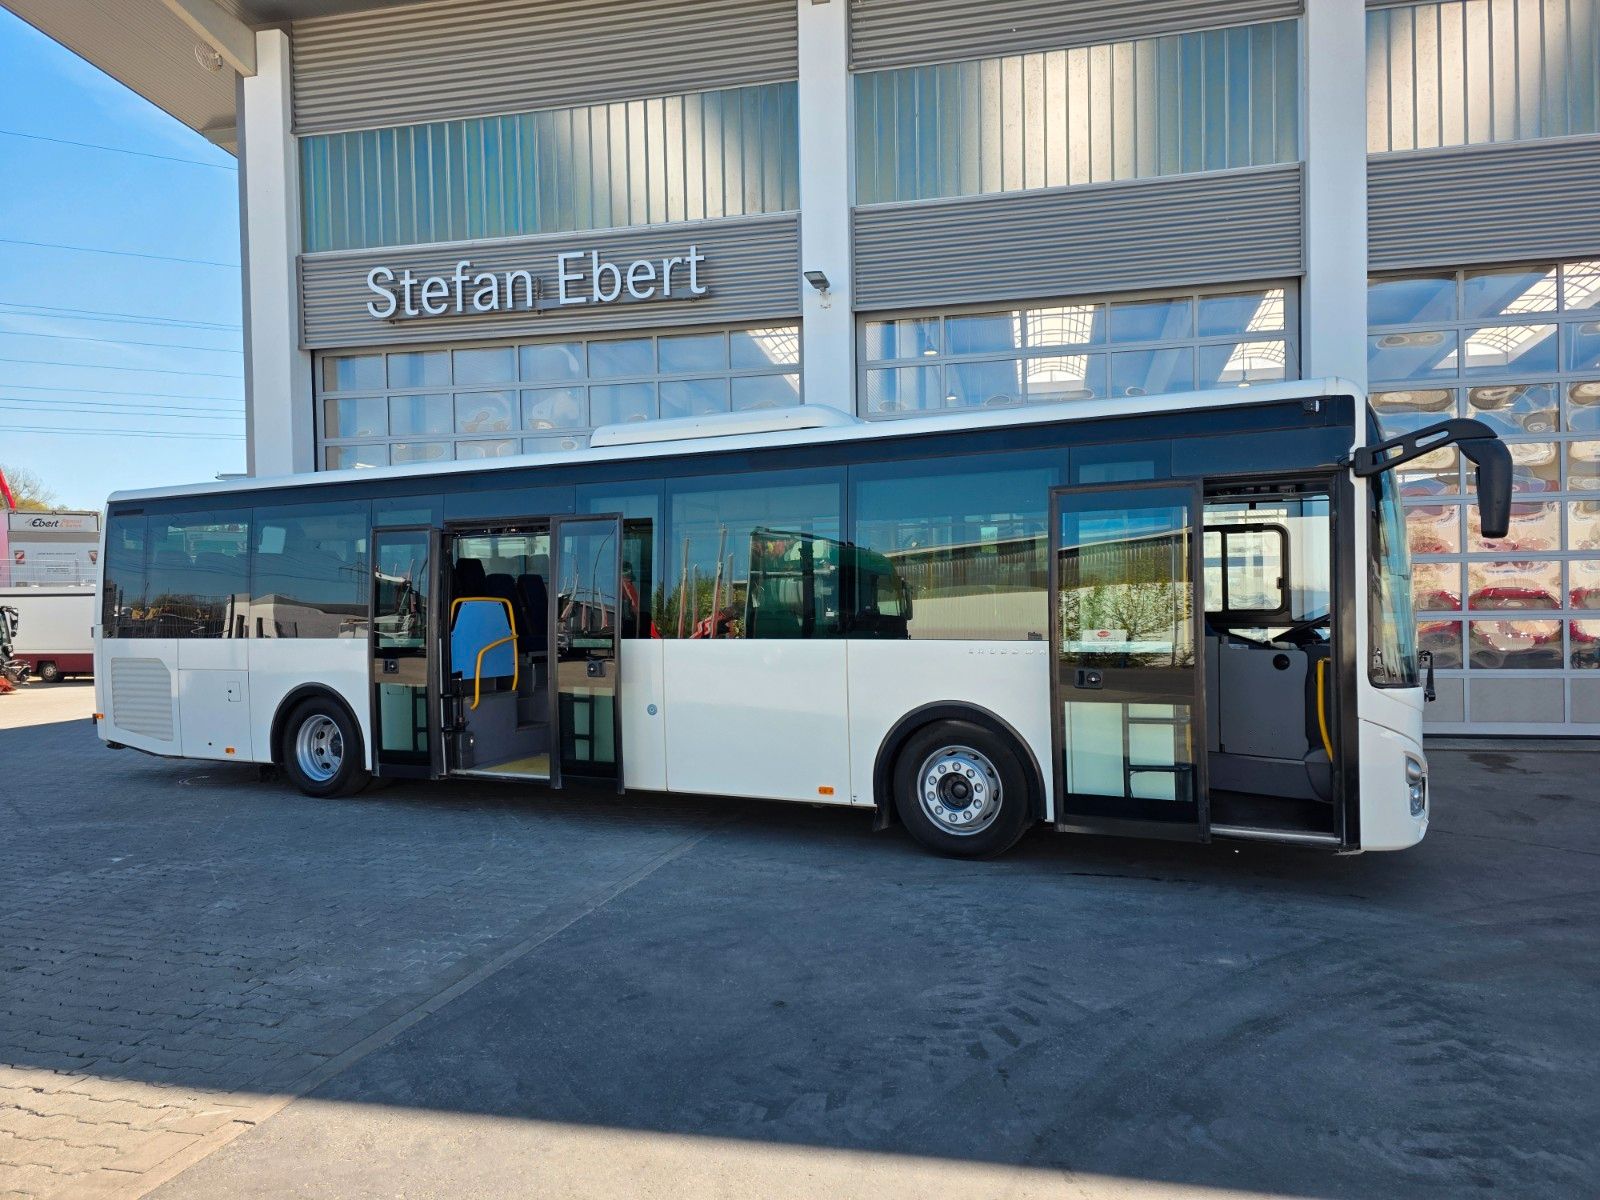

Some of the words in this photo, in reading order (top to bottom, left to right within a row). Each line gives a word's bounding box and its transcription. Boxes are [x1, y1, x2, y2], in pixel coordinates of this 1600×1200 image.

[366, 260, 534, 318] Stefan
[557, 245, 706, 305] Ebert
[32, 518, 59, 528] Ebert
